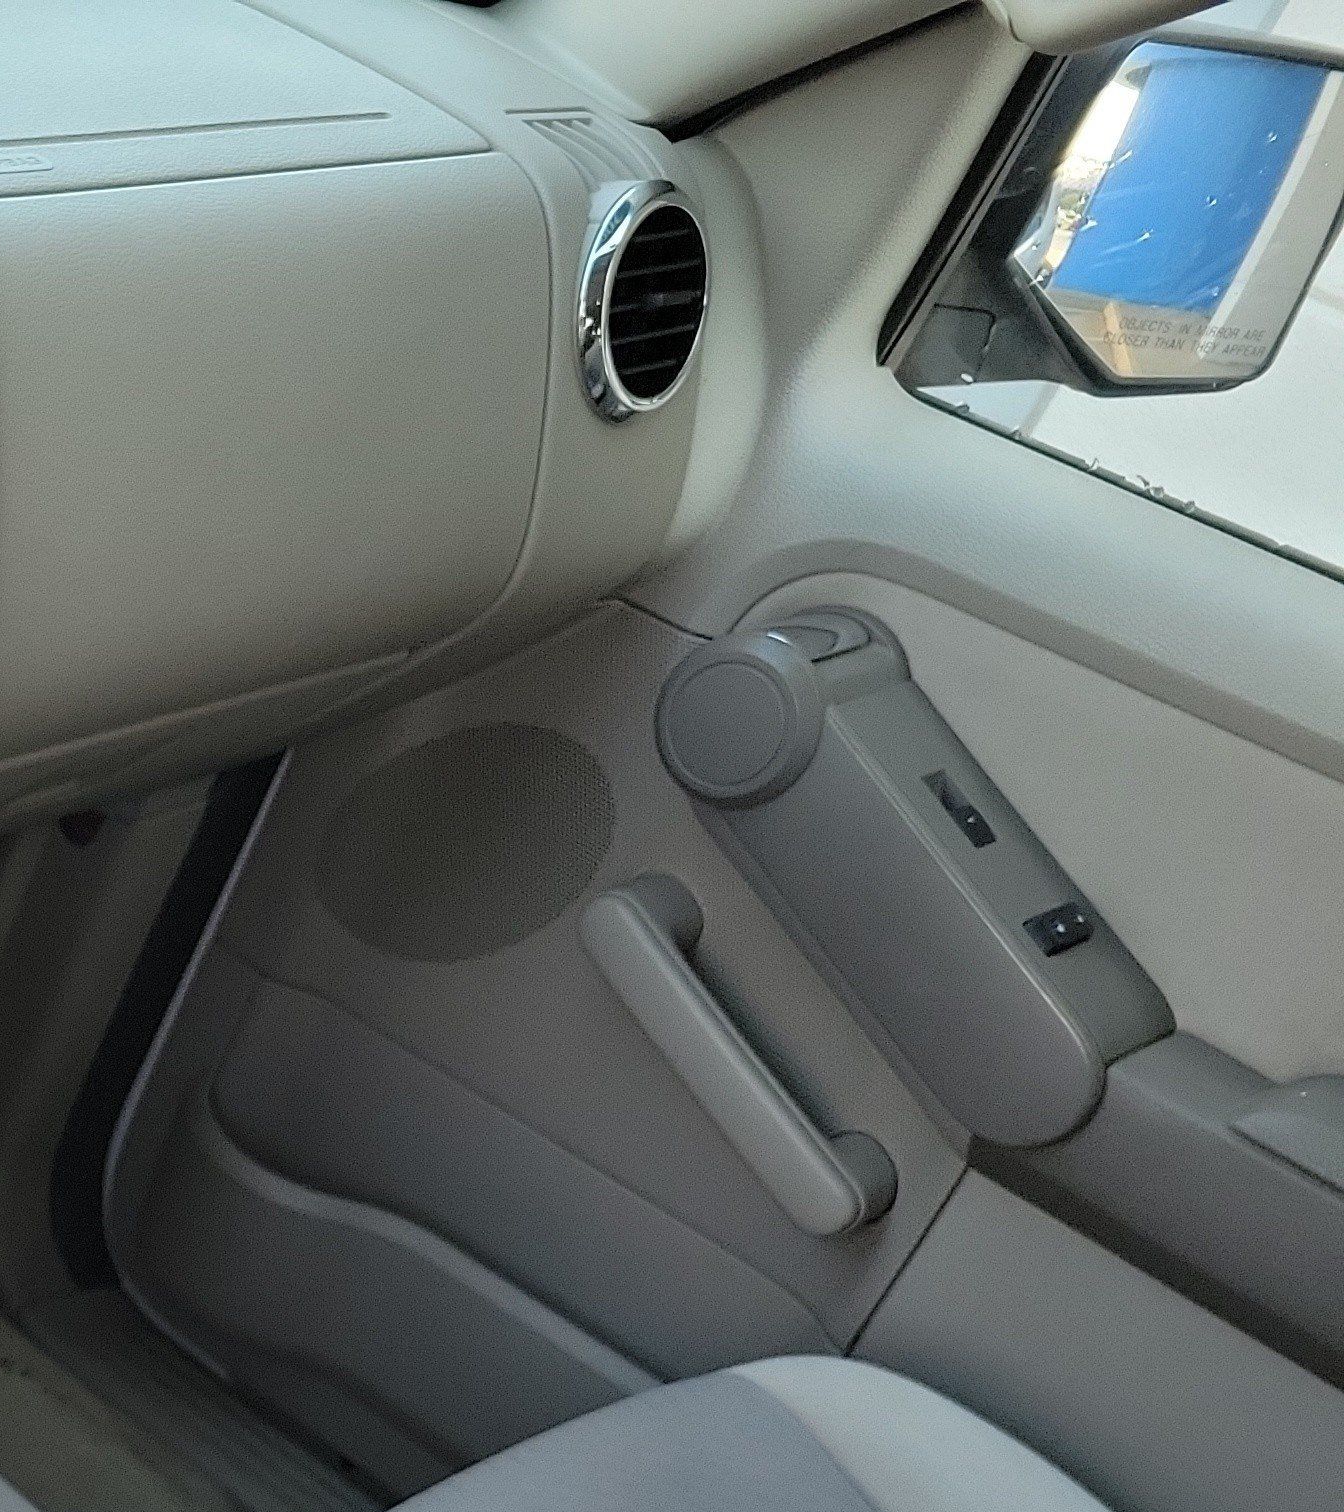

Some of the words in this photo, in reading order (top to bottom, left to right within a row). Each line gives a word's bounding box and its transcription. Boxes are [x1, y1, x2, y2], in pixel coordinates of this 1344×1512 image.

[1119, 317, 1172, 333] OBJECTS
[1179, 323, 1191, 334] IN
[1243, 330, 1267, 342] ARE
[1103, 332, 1150, 347] CLOSER
[1155, 336, 1186, 350] THAN
[1222, 344, 1267, 358] APPEAR
